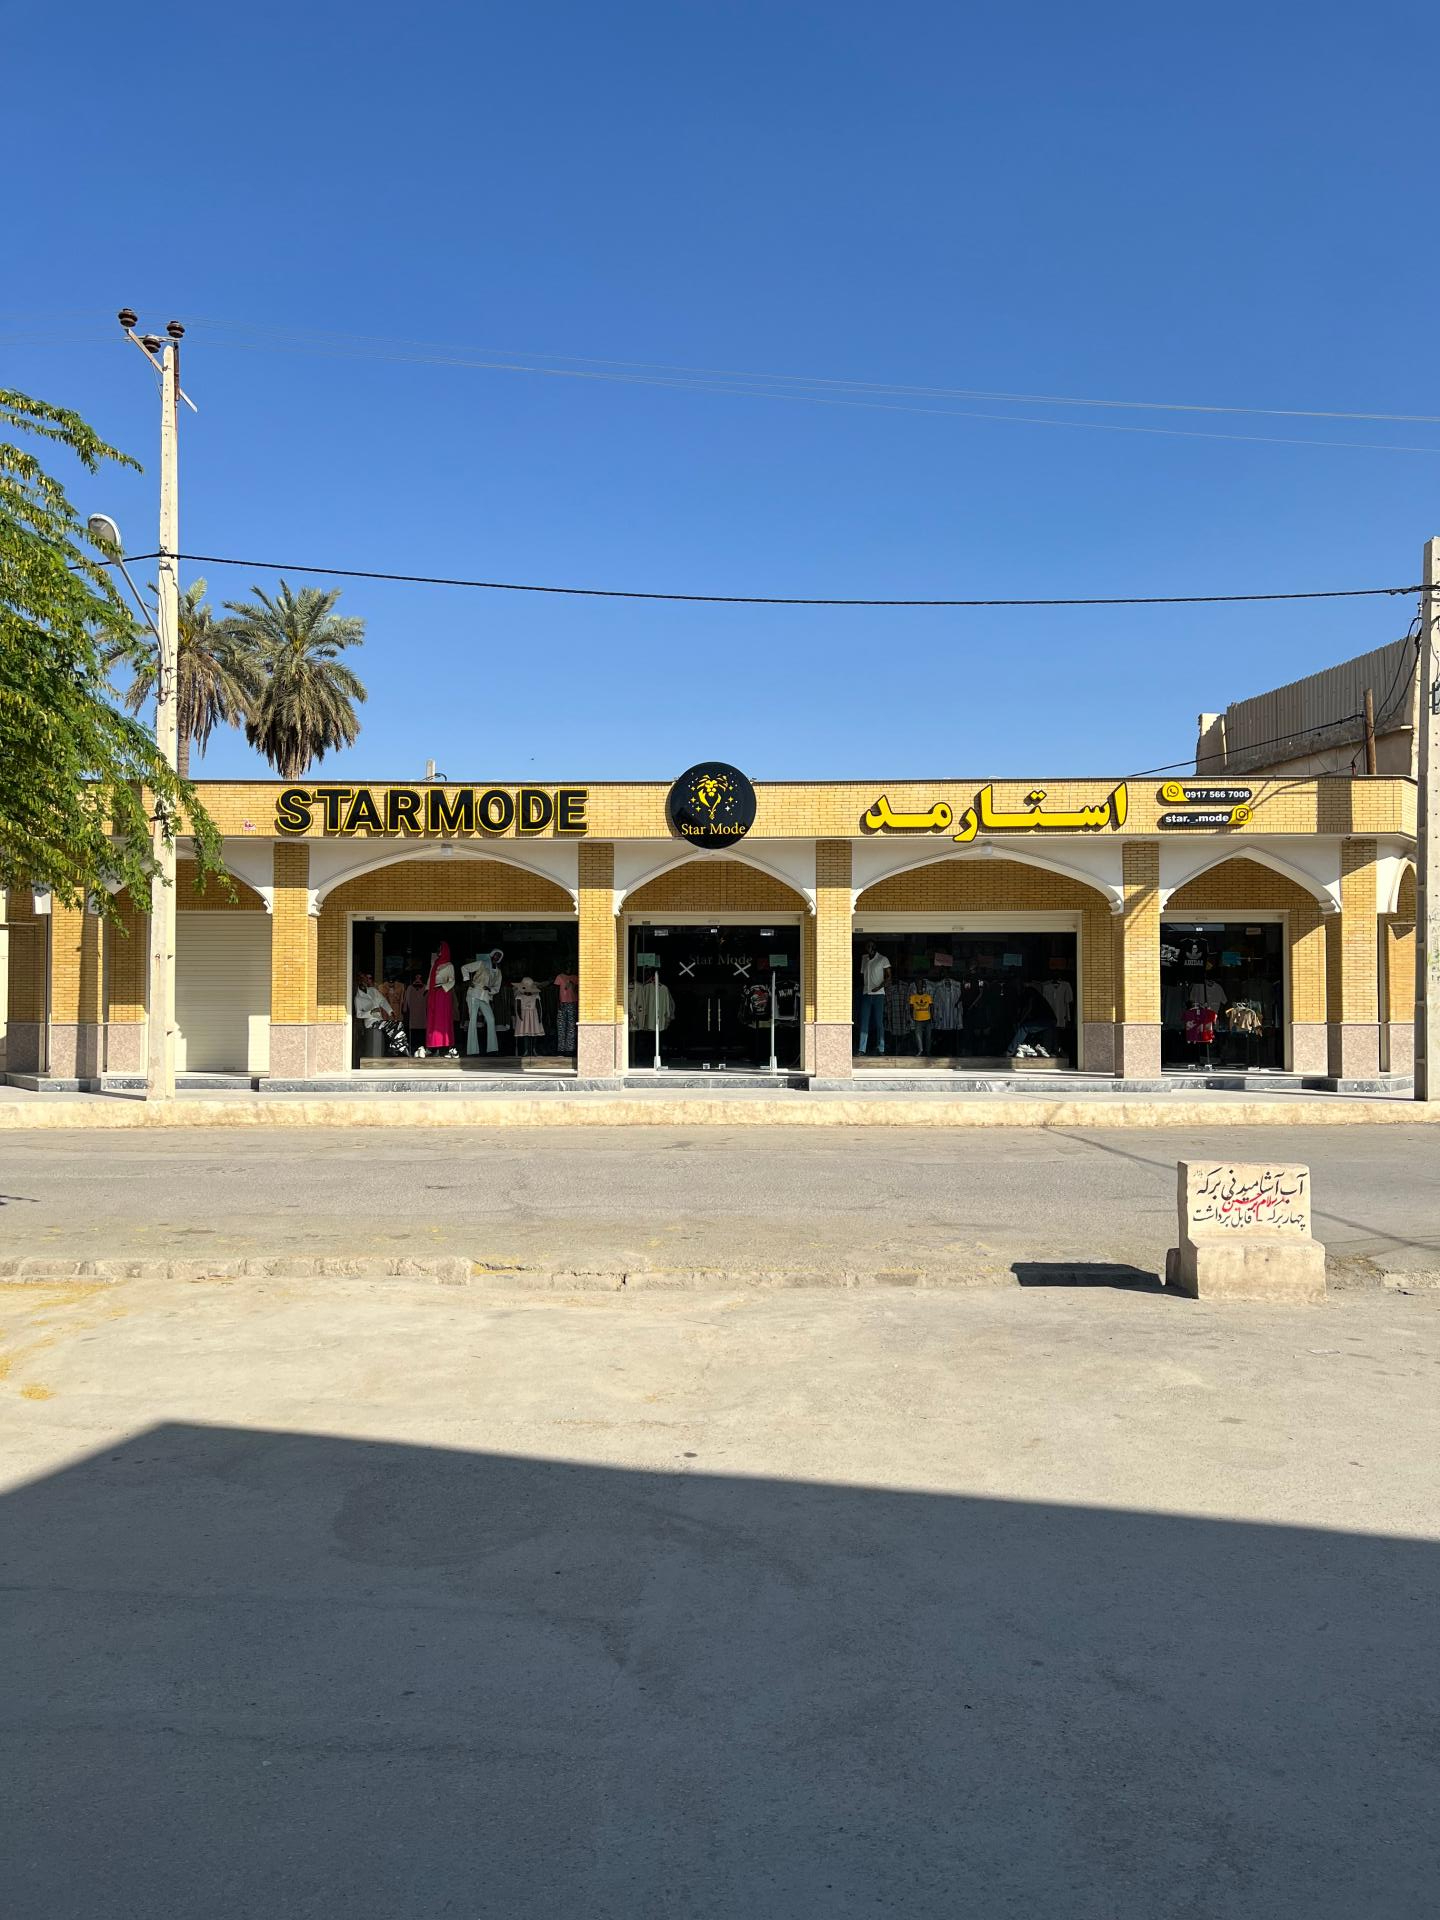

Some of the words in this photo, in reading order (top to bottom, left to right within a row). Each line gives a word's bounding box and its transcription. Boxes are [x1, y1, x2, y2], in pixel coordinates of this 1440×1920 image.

[1185, 790, 1206, 799] 0917
[1209, 790, 1226, 799] 566
[1228, 790, 1250, 798] 7006
[277, 787, 590, 833] STARMODE
[681, 823, 707, 836] Star
[709, 822, 746, 835] Mode
[717, 952, 753, 966] Mode
